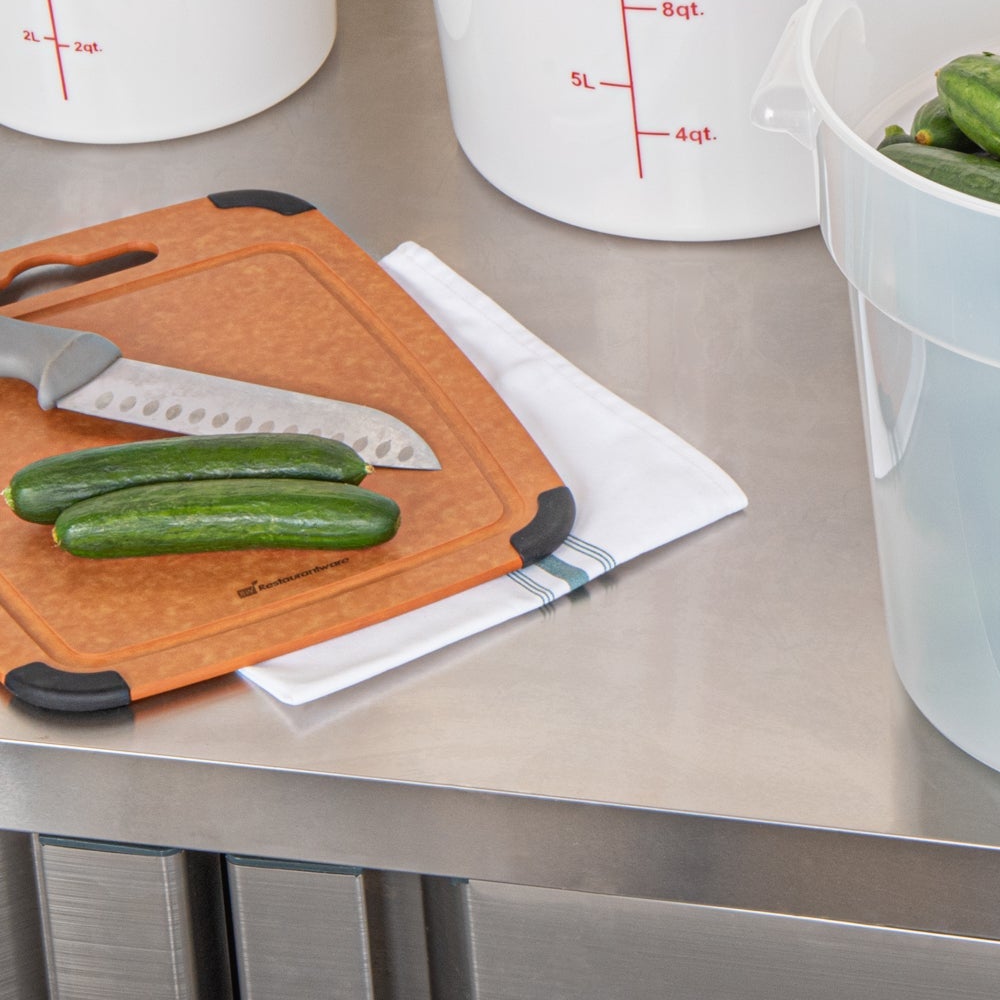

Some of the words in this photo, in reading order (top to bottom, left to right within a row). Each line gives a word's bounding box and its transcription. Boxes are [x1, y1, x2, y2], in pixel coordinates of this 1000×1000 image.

[661, 1, 704, 20] 8qt.
[23, 30, 40, 42] 2L
[74, 41, 103, 54] 2qt.
[570, 71, 596, 90] 5L
[675, 126, 717, 145] 4qt.
[258, 557, 350, 591] Restaurantware
